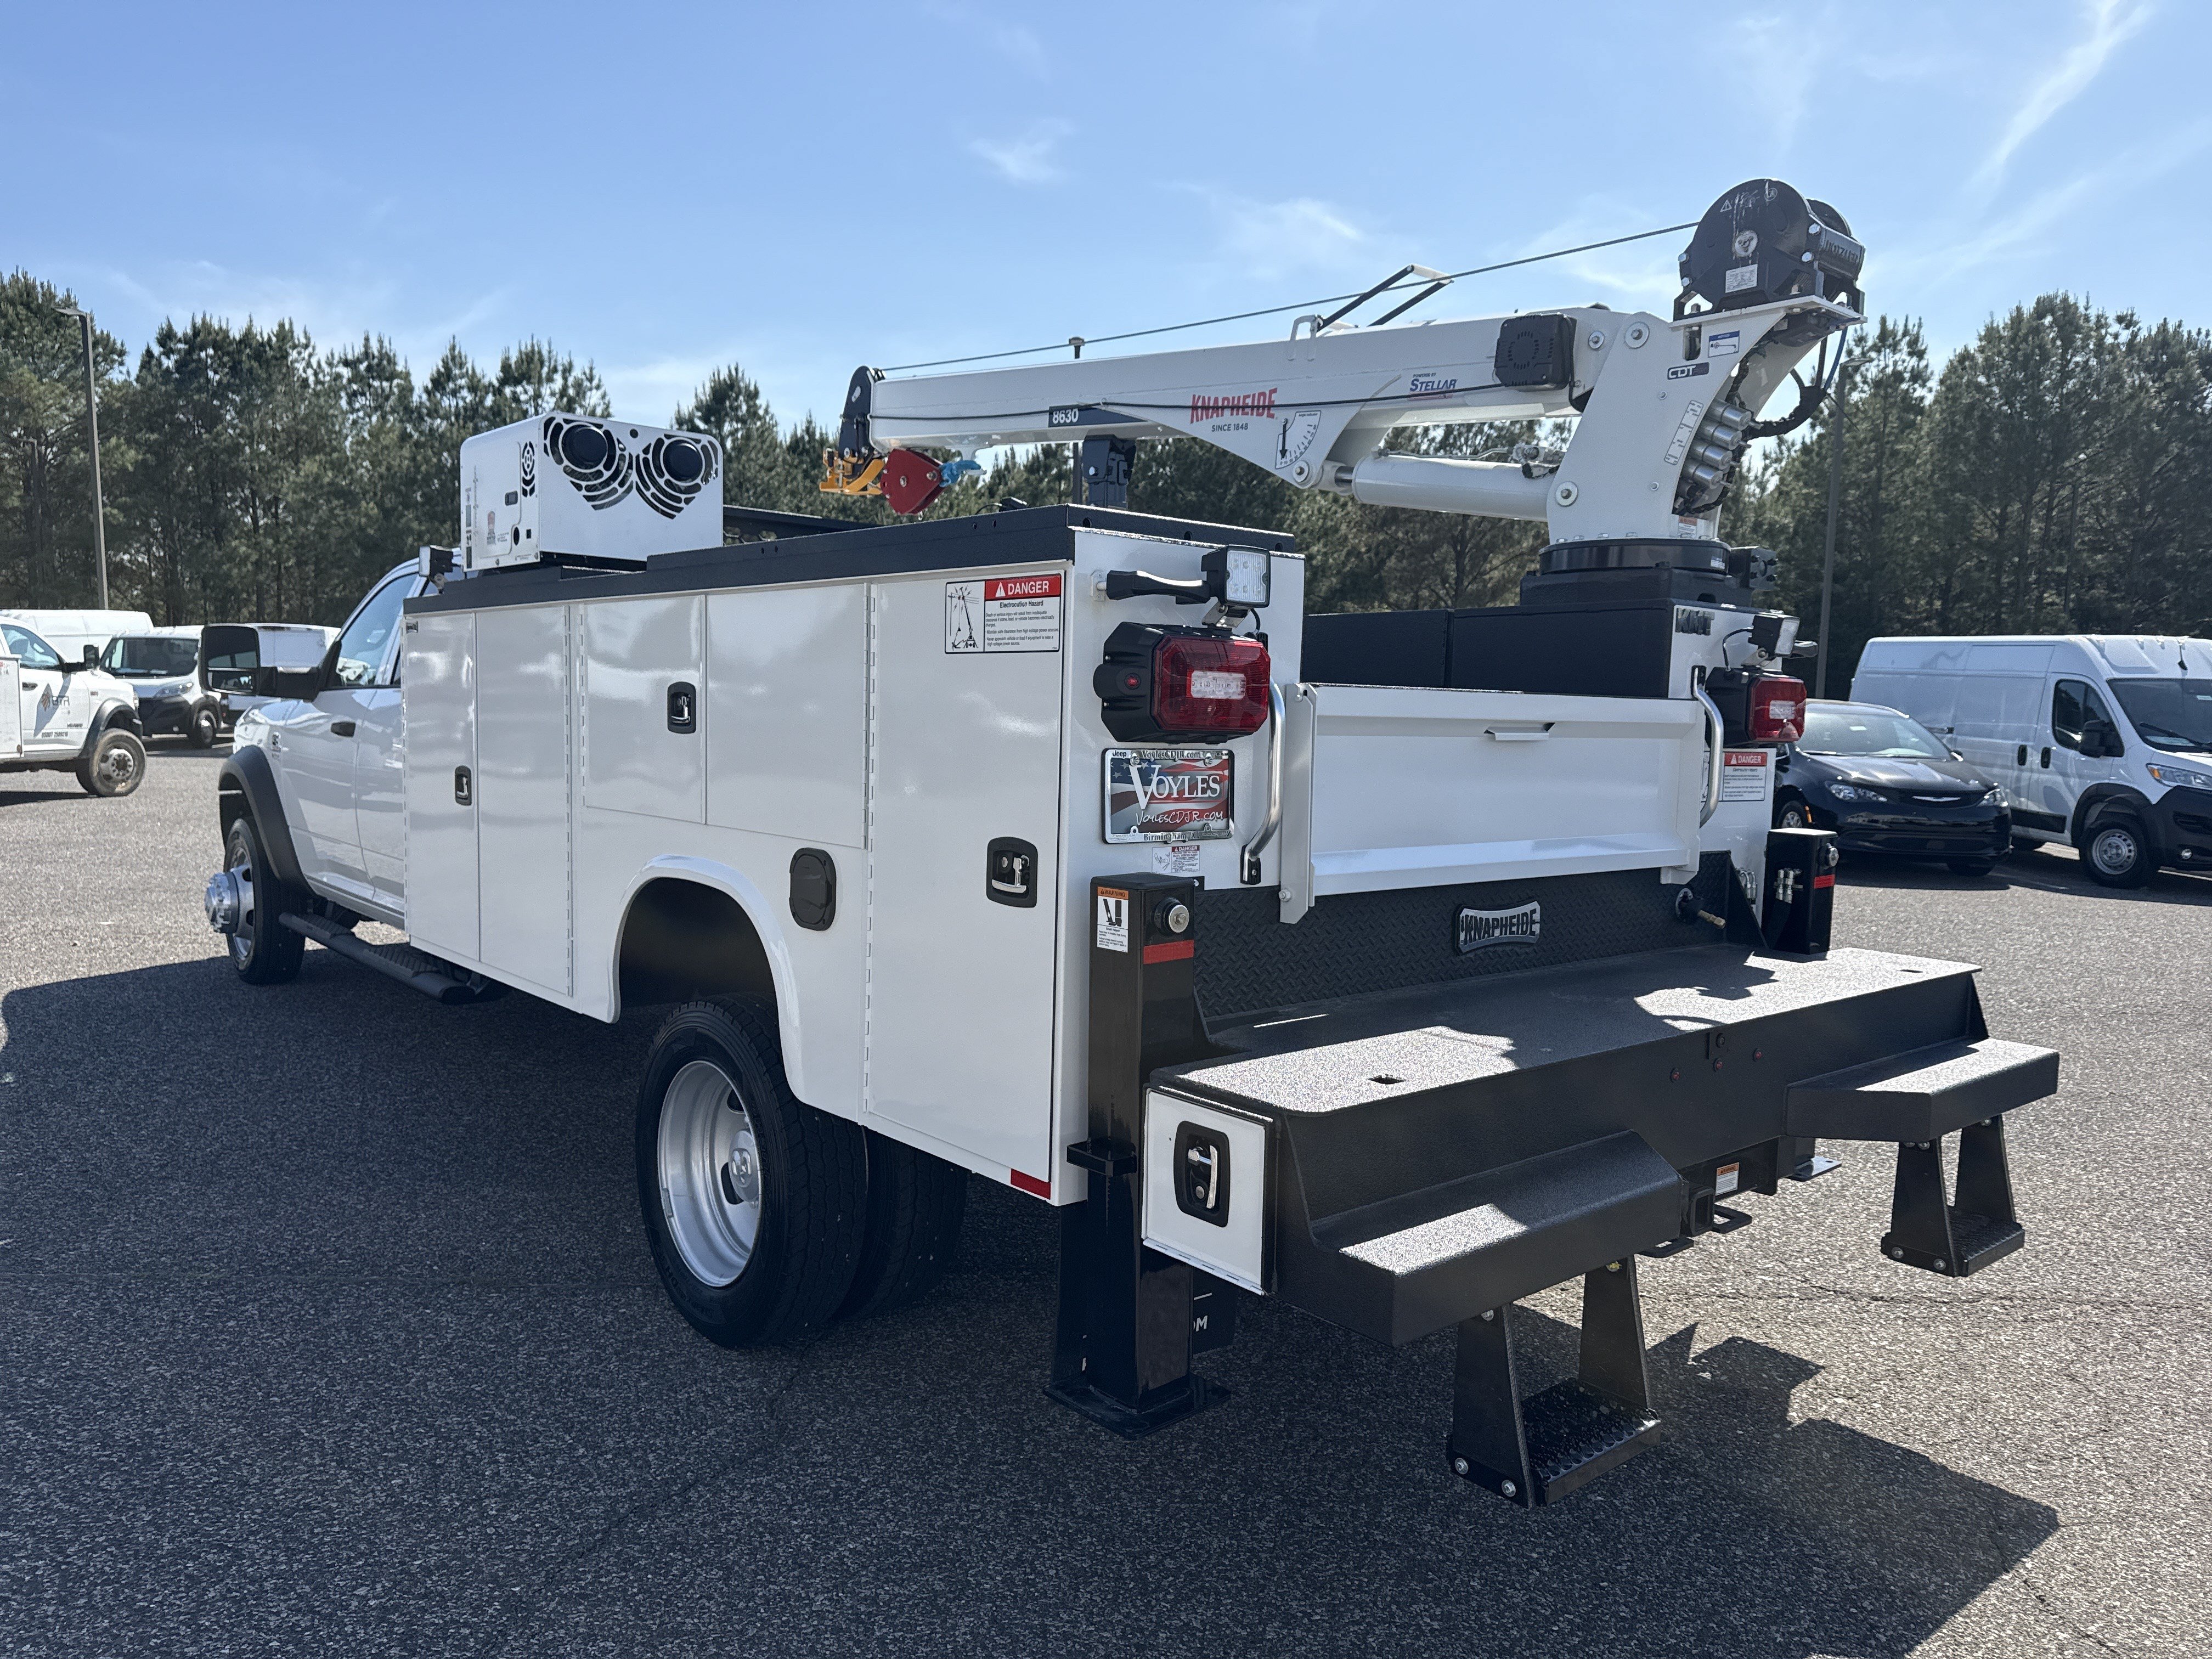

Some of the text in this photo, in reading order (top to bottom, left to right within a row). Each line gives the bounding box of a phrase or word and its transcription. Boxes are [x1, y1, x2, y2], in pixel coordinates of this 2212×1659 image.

[1410, 379, 1457, 391] STELLAR
[1190, 387, 1278, 424] KNAPHEIDE
[1052, 408, 1079, 424] 8630
[1008, 580, 1049, 595] DANGER
[1675, 608, 1715, 636] KMT
[1141, 750, 1201, 761] VoylesCDJR.com
[1737, 755, 1762, 764] DANGER
[1129, 765, 1221, 809] VOYLES
[1104, 889, 1125, 898] WARNING
[1464, 908, 1537, 946] KNAPHEIDE
